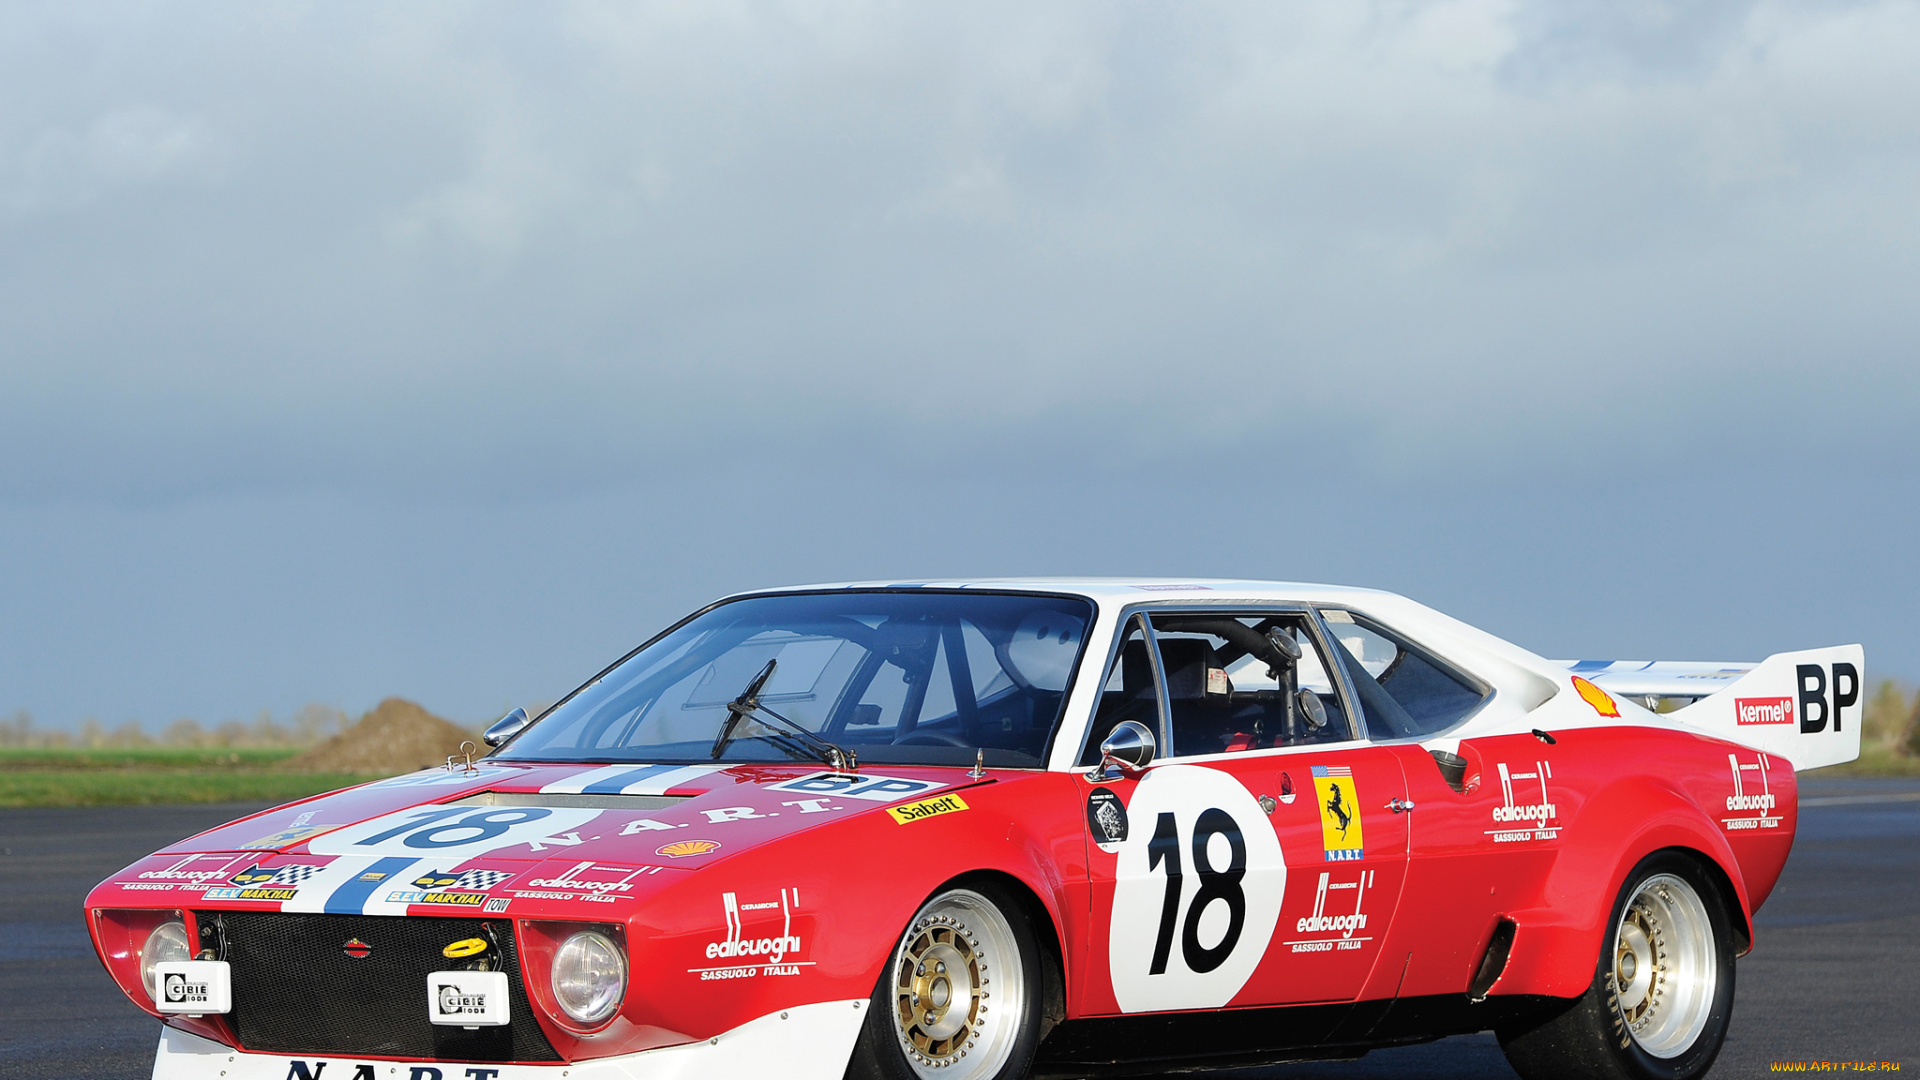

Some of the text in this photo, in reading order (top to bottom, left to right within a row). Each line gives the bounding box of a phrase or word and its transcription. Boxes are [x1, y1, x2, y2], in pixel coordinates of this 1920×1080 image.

[1796, 663, 1859, 734] BP
[780, 773, 929, 795] BP
[896, 797, 961, 820] Sabelt
[353, 806, 554, 849] 18
[1727, 819, 1779, 830] SASSUOLO ITALIA
[1493, 830, 1558, 843] SASSUOLO ITALIA
[239, 889, 297, 900] MARCHAL
[513, 891, 616, 903] SASSUOLO ITALIA
[1148, 808, 1247, 975] 18
[423, 893, 483, 904] MARCHAL
[485, 899, 511, 911] TOW
[741, 902, 779, 911] CERAMICHE
[1292, 941, 1361, 953] SASSUOLO ITALIA
[701, 966, 800, 980] SASSUOLO ITALIA
